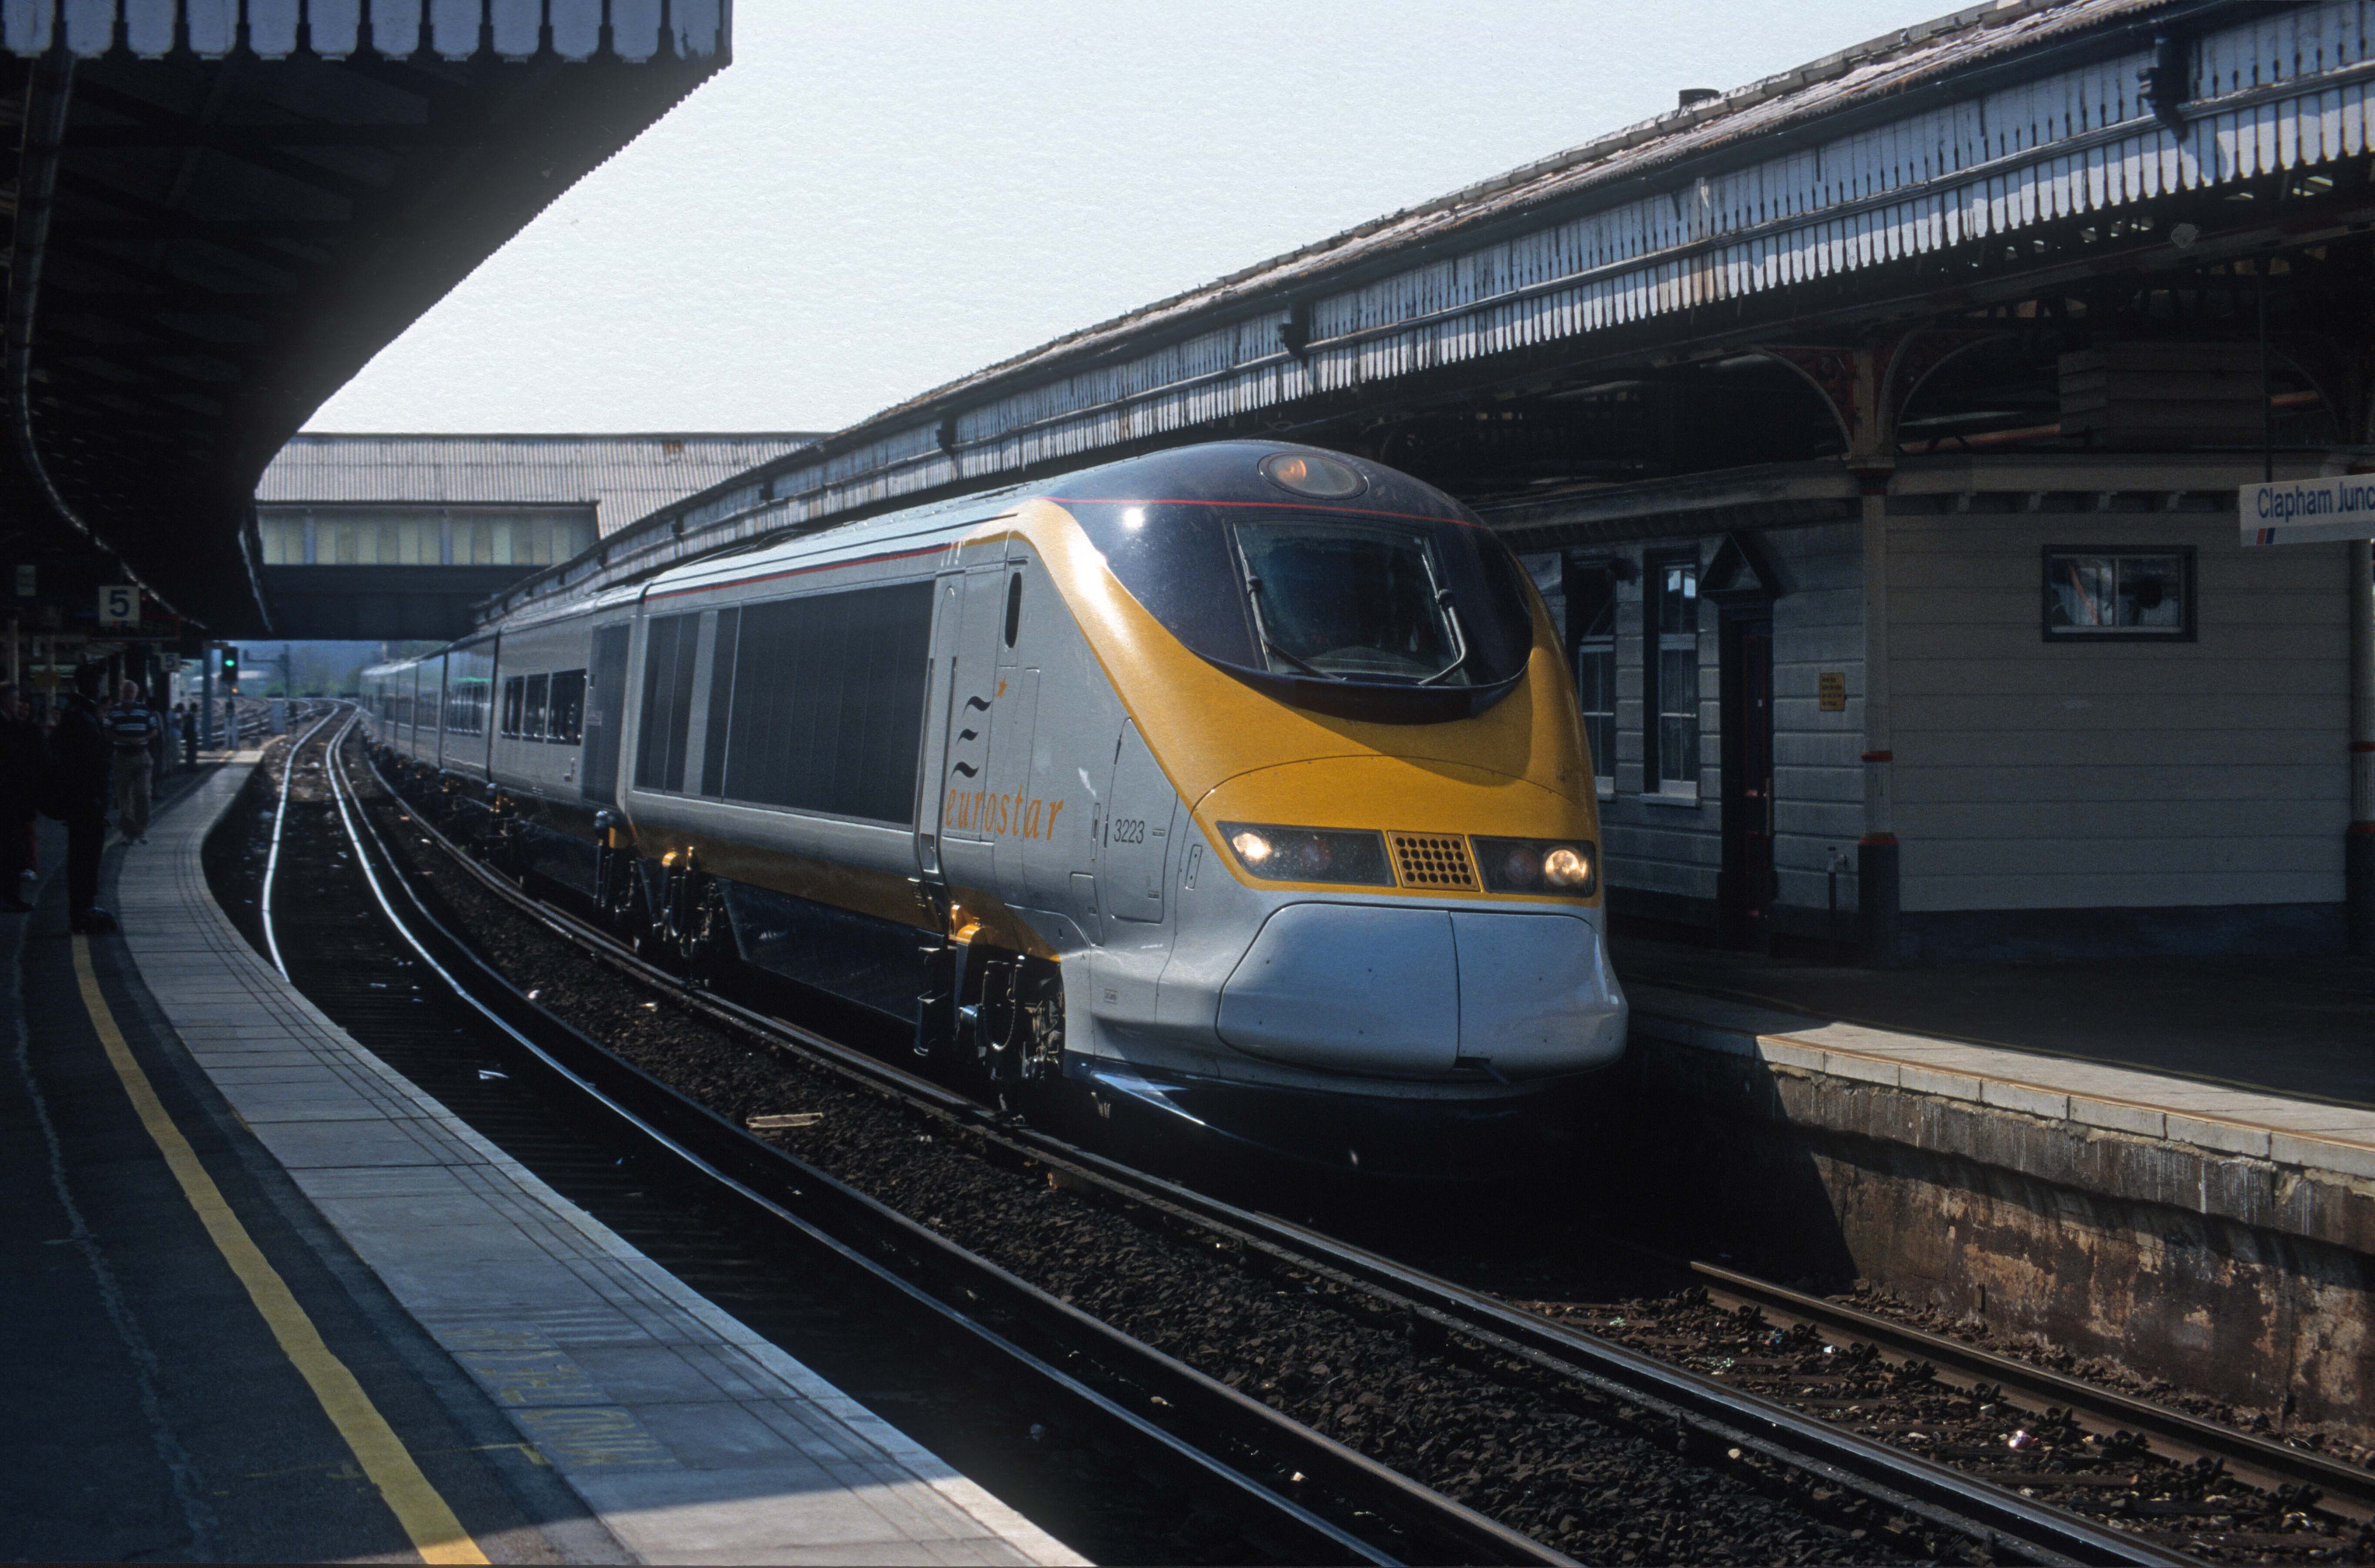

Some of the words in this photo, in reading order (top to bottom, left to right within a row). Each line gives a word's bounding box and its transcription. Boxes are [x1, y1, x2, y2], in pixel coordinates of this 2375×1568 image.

[2257, 485, 2333, 522] Clapham
[2338, 481, 2375, 512] Junc
[109, 589, 130, 618] 5
[165, 654, 177, 669] 5
[945, 784, 1064, 840] eurostar
[1114, 819, 1144, 845] 3223
